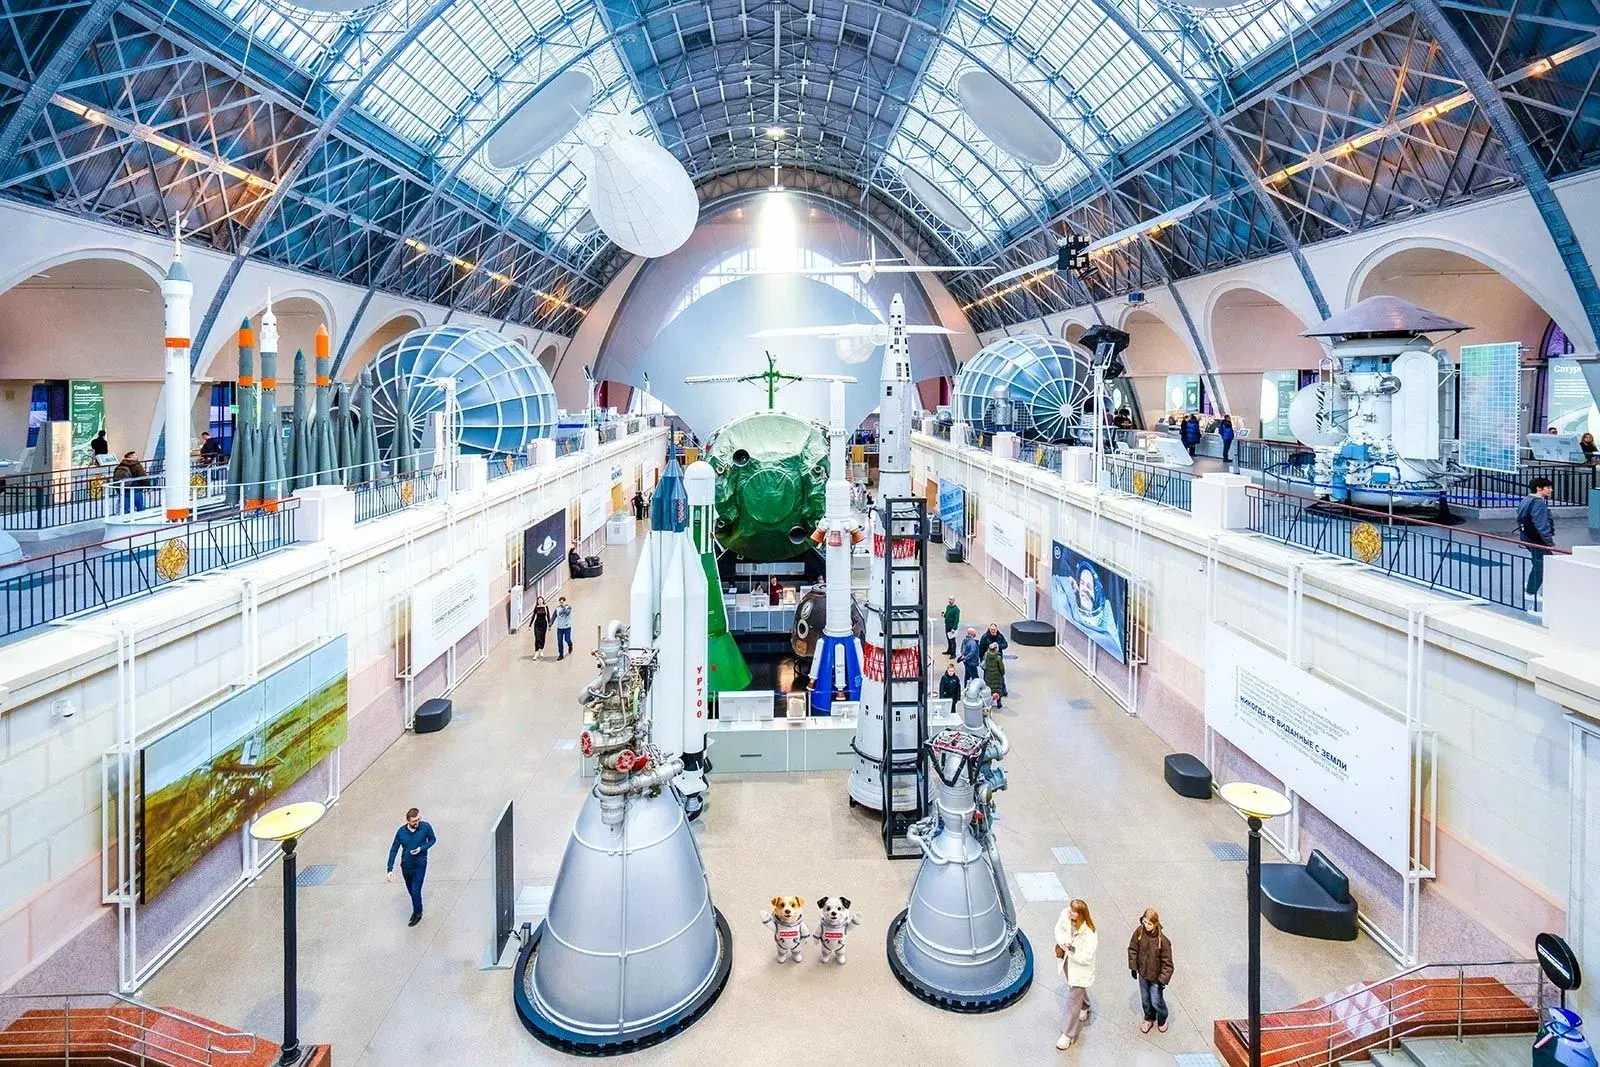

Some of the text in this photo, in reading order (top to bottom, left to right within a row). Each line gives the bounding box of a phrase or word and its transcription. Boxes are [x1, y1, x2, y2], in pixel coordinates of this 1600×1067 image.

[1240, 695, 1348, 772] НИКОГДА НЕ ВИДАННЫЕ С ЗЕМЛИ
